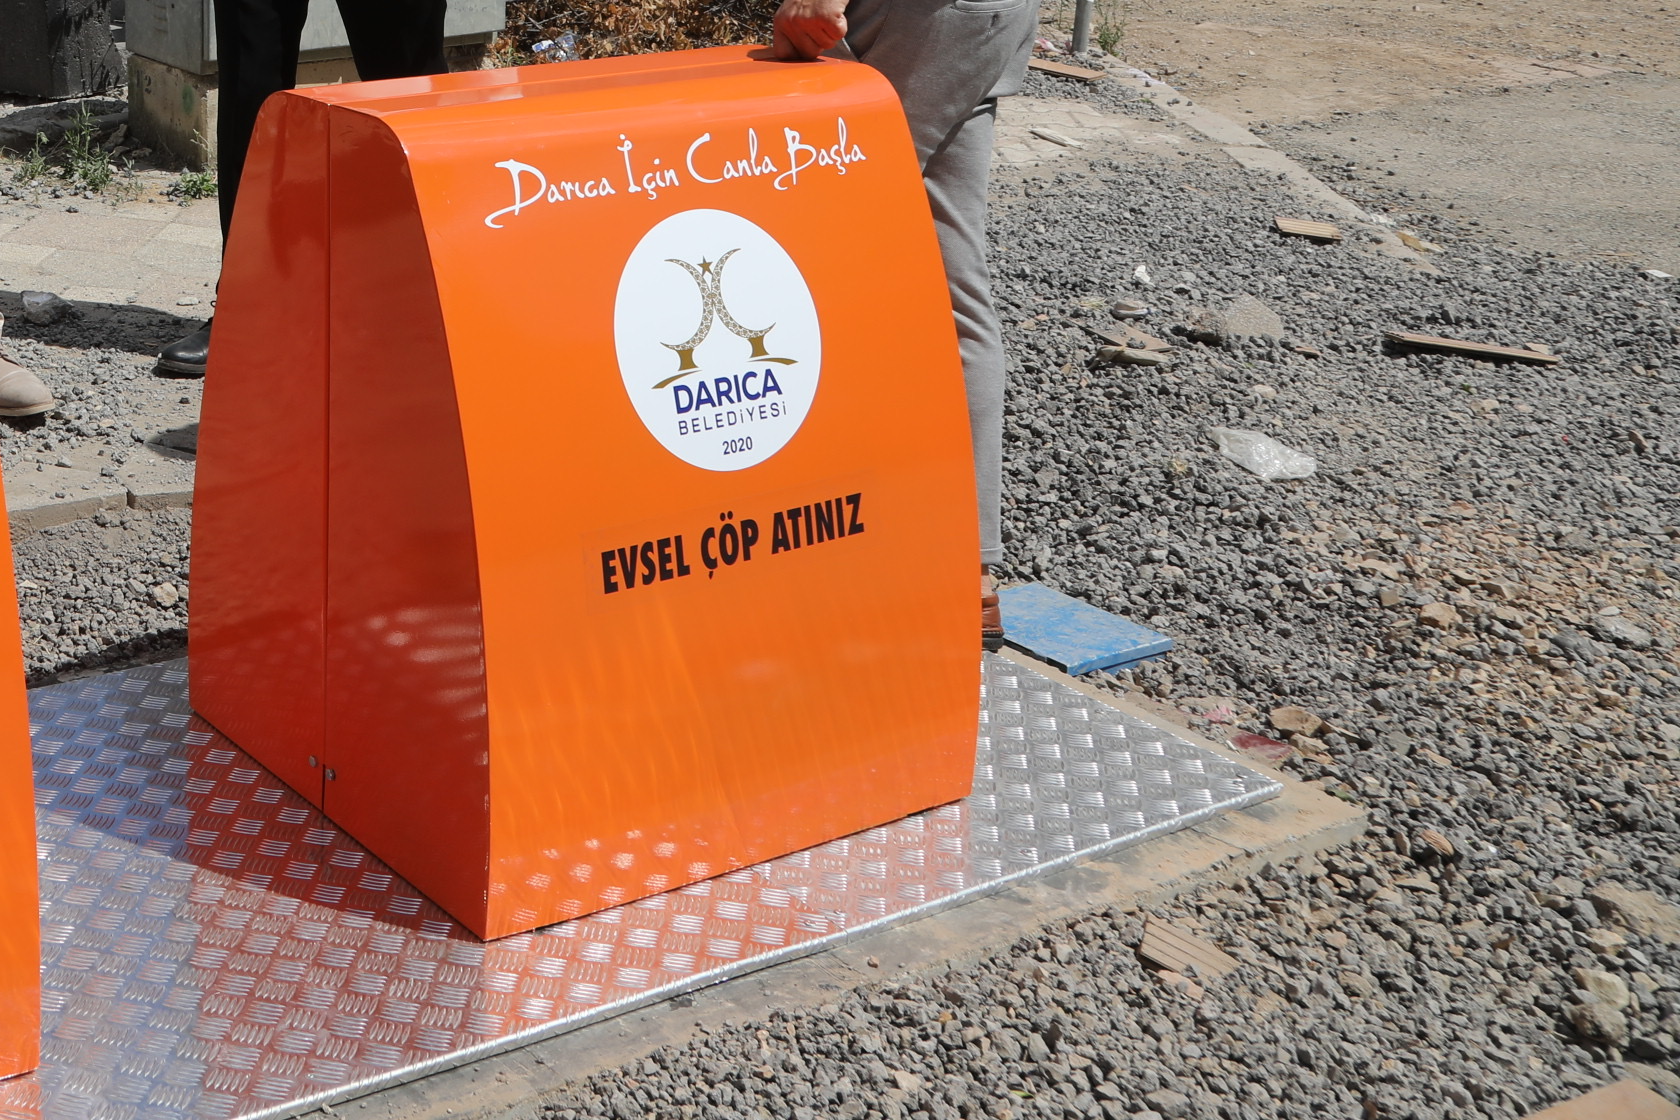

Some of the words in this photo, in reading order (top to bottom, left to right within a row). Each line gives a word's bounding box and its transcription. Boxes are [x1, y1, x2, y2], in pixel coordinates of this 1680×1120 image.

[484, 158, 615, 229] Darıca
[617, 133, 679, 200] İçin
[686, 127, 777, 183] Canla
[774, 117, 866, 190] Başla
[673, 368, 783, 415] DARICA
[722, 436, 753, 456] 2020
[600, 535, 691, 595] EVSEL
[700, 510, 760, 581] ÇÖP
[771, 492, 865, 555] ATINIZ
